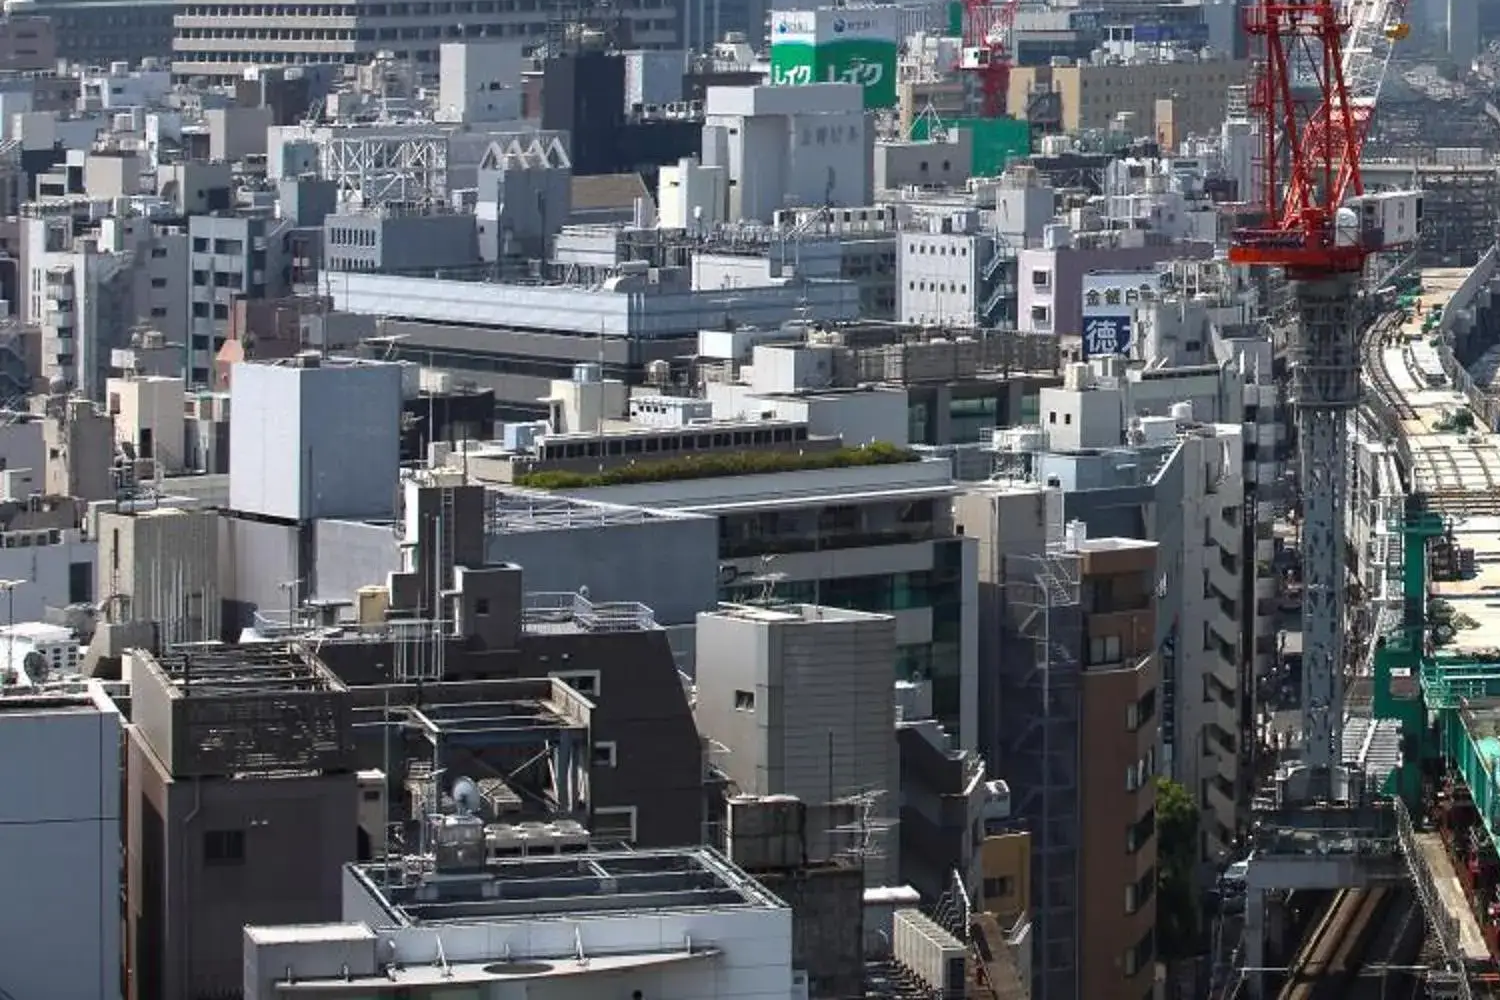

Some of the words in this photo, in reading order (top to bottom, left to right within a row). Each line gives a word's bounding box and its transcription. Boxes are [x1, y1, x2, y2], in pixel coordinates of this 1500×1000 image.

[775, 64, 811, 85] レイク
[828, 63, 882, 86] レイク
